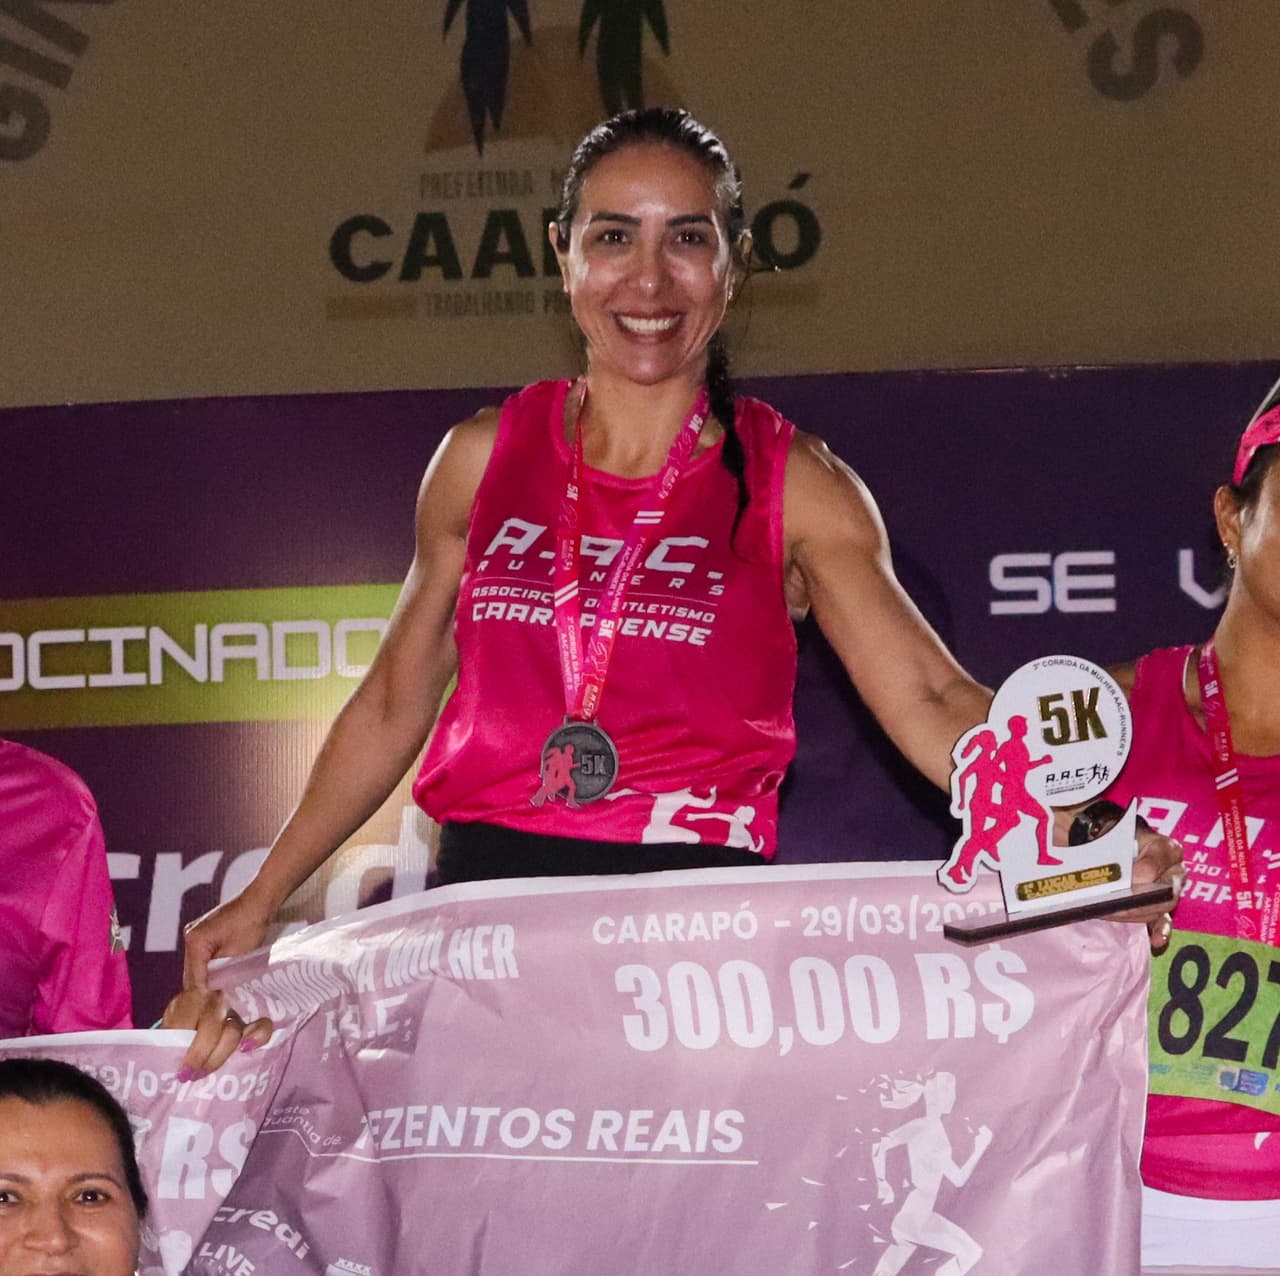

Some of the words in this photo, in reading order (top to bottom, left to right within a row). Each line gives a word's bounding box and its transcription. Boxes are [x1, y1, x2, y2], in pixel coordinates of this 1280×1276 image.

[988, 549, 1117, 617] SE
[1036, 686, 1108, 747] 5K
[591, 900, 758, 945] CAARAPÓ
[614, 953, 902, 1057] 300,00
[912, 942, 1036, 1045] R$
[586, 1108, 746, 1154] REAIS
